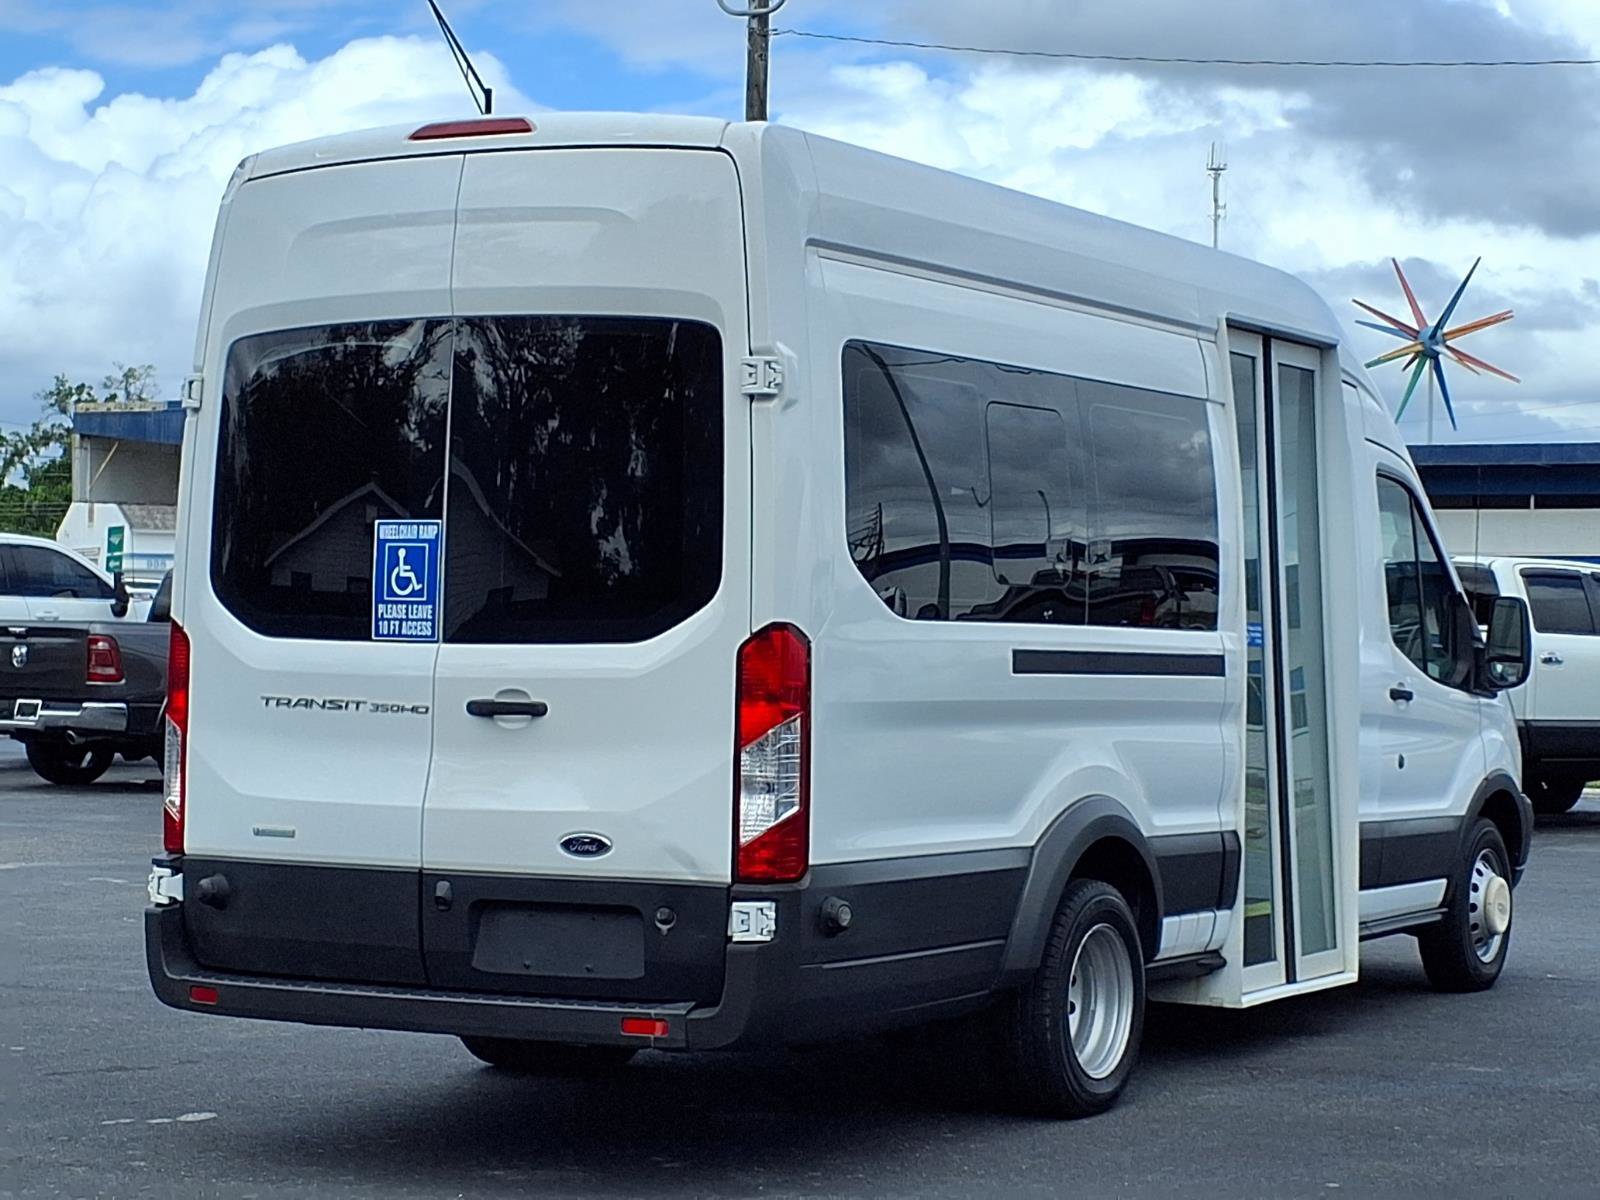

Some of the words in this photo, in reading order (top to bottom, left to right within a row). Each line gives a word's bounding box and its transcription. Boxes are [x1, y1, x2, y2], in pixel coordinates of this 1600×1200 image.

[378, 604, 406, 619] PLEASE
[408, 605, 432, 619] LEAVE
[379, 620, 388, 635] 10
[390, 620, 399, 635] FT
[401, 620, 432, 635] ACCESS
[260, 696, 368, 712] TRANSIT
[369, 702, 430, 715] 350HD
[570, 839, 598, 851] Ford
